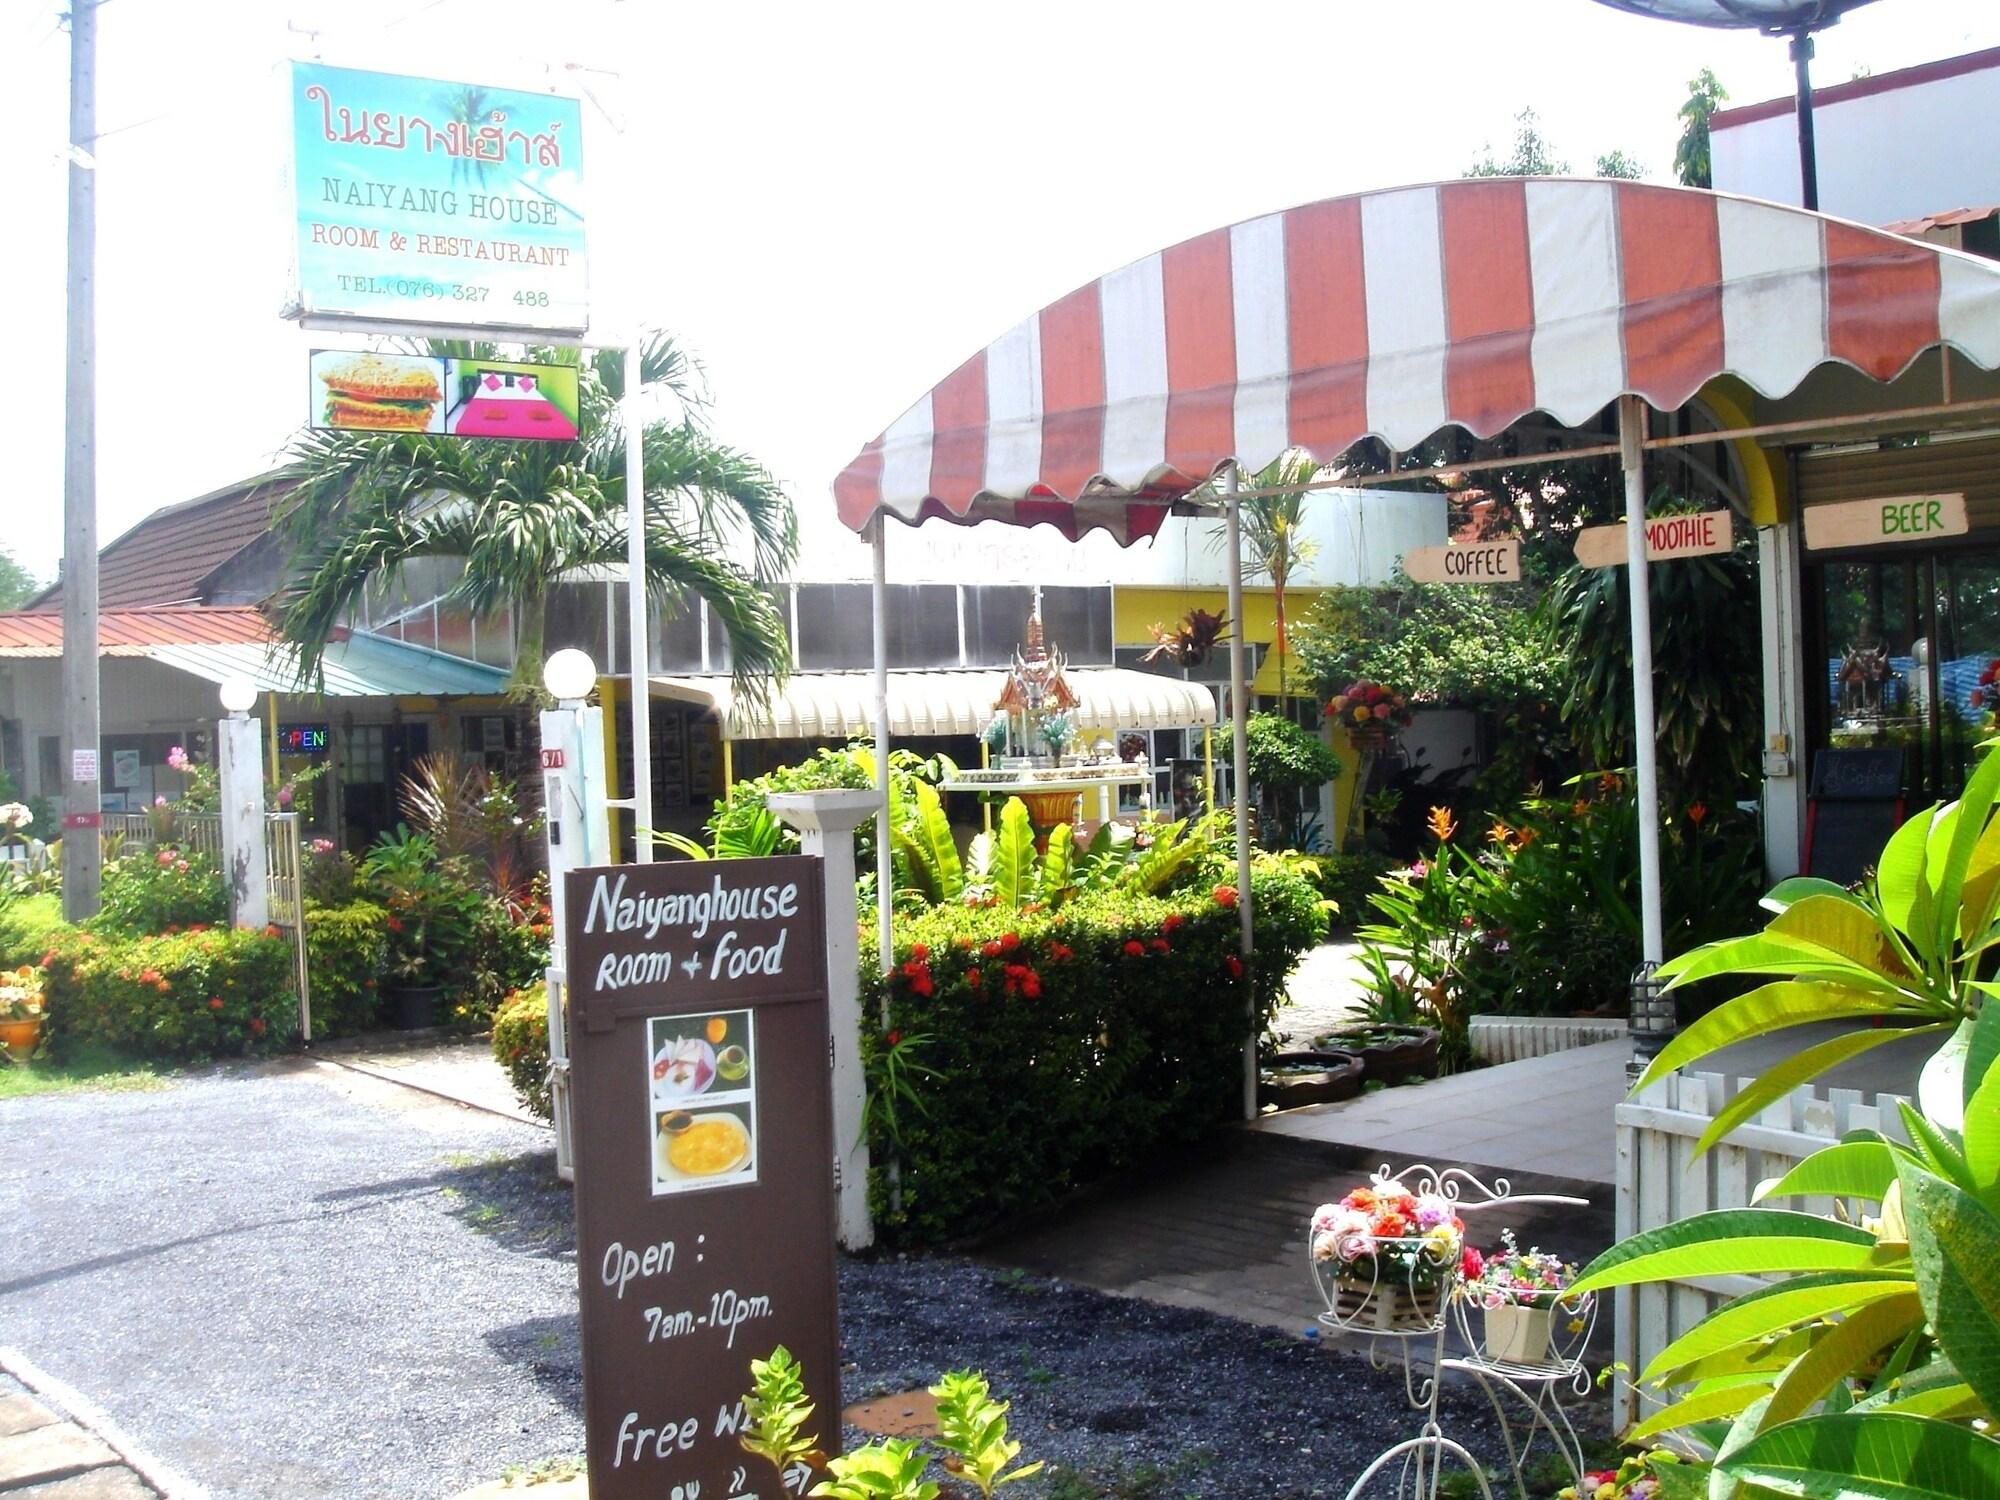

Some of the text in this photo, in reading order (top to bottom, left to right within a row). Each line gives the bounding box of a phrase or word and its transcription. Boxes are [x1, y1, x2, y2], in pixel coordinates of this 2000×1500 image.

[306, 86, 562, 168] ในยางเฮ้าส์
[322, 177, 558, 226] NAIYANG HOUSE
[311, 223, 570, 267] ROOM & RESTAURANT
[452, 284, 490, 303] 327
[512, 290, 549, 308] 488
[1645, 514, 1716, 551] MOOTHIE
[1881, 501, 1944, 535] BEER
[1445, 547, 1508, 576] COFFEE
[584, 874, 799, 939] Naiyanghouse
[602, 1241, 675, 1299] Open
